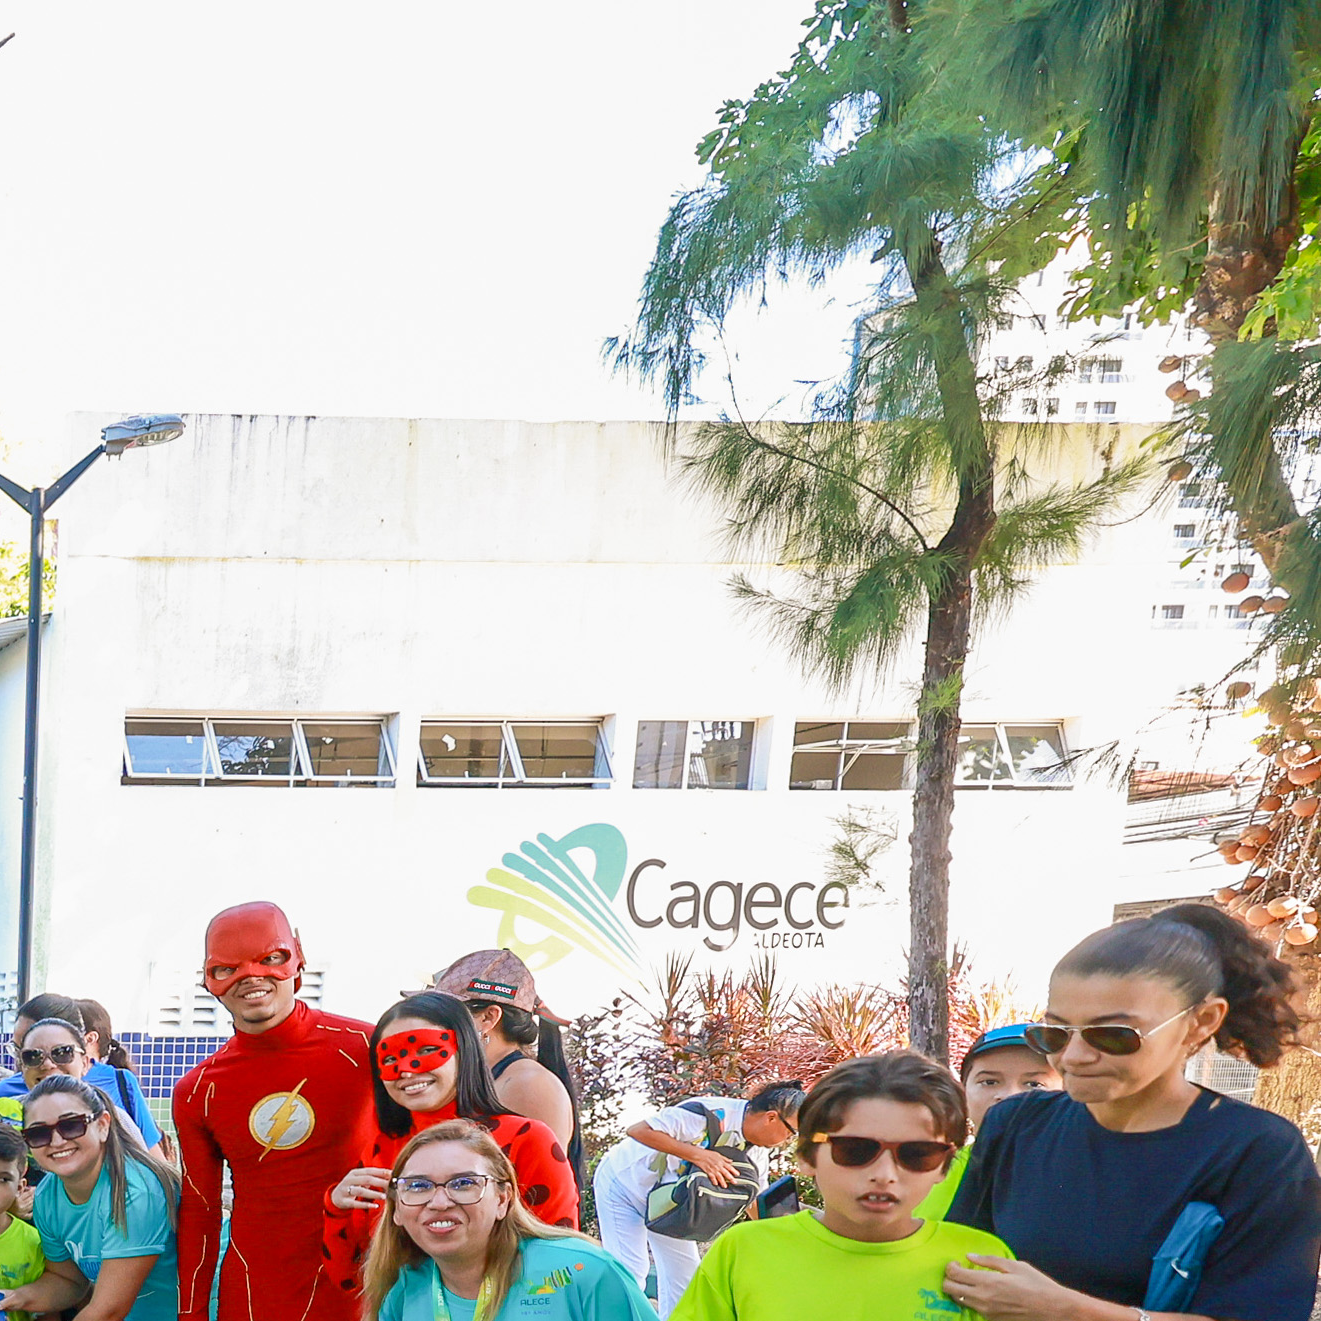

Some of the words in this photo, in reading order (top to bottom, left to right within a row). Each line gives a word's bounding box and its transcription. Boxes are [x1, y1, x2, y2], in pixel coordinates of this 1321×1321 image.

[627, 858, 850, 952] Cagece
[474, 982, 491, 990] GUCCI
[494, 985, 512, 994] GUCCI
[520, 1297, 550, 1306] ALECE
